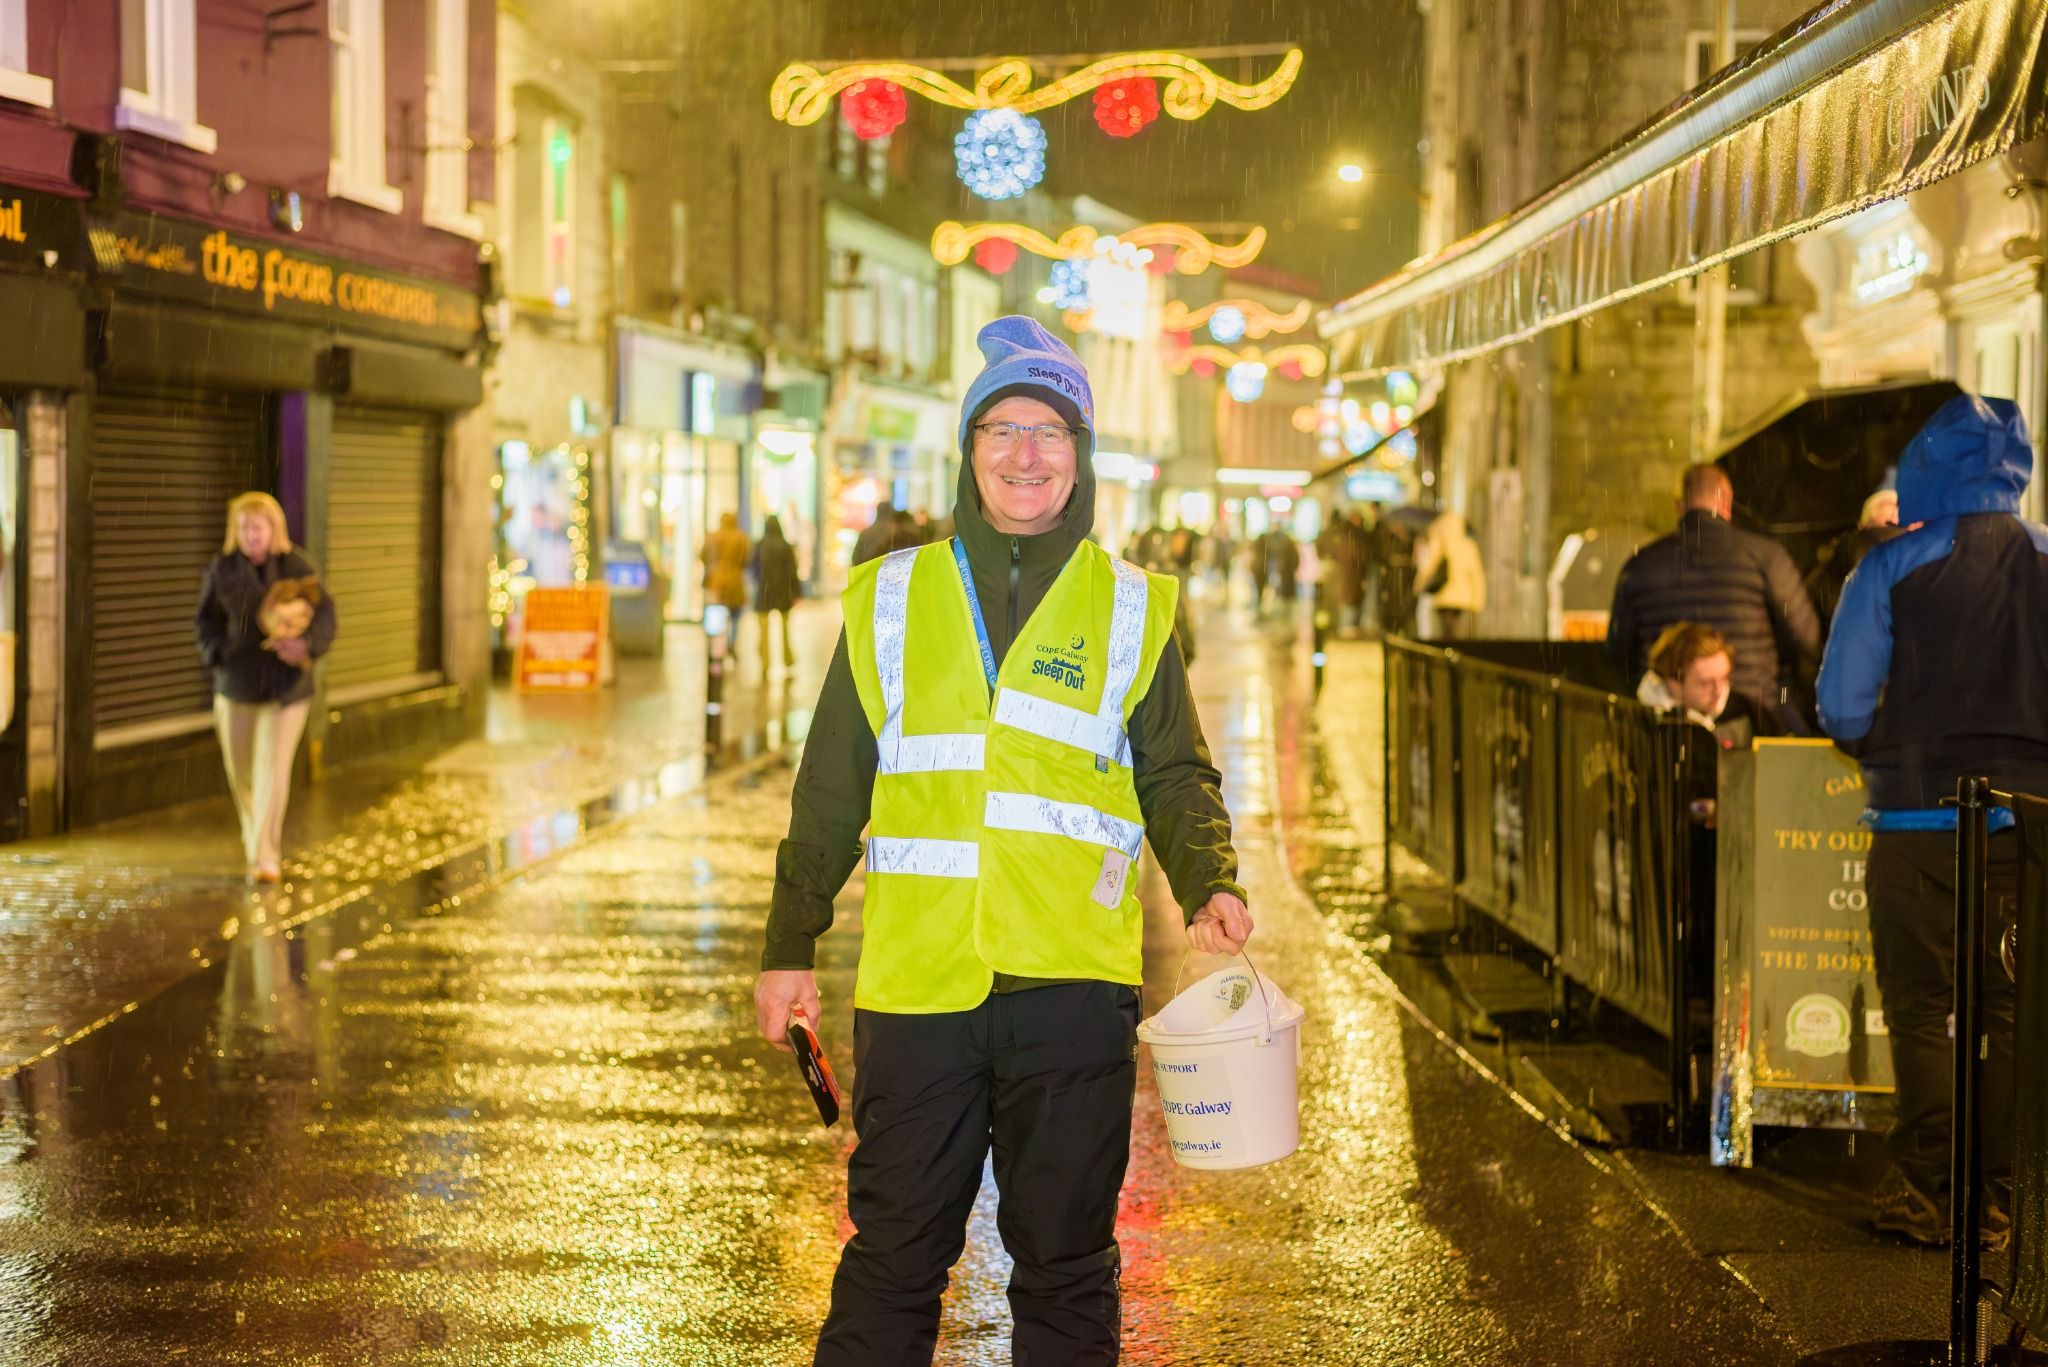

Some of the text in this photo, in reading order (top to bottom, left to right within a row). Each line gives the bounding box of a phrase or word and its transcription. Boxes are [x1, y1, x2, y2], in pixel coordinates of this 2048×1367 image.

[202, 230, 258, 291] the
[1028, 367, 1081, 401] Sleep Out
[960, 568, 972, 589] COPE
[981, 650, 993, 675] COPE
[1036, 644, 1089, 663] COPE Galway
[1032, 659, 1085, 691] Sleep Out
[1774, 829, 1822, 850] TRY
[1760, 950, 1808, 970] THE
[1160, 1063, 1198, 1073] SUPPORT
[1185, 1101, 1232, 1115] Galway
